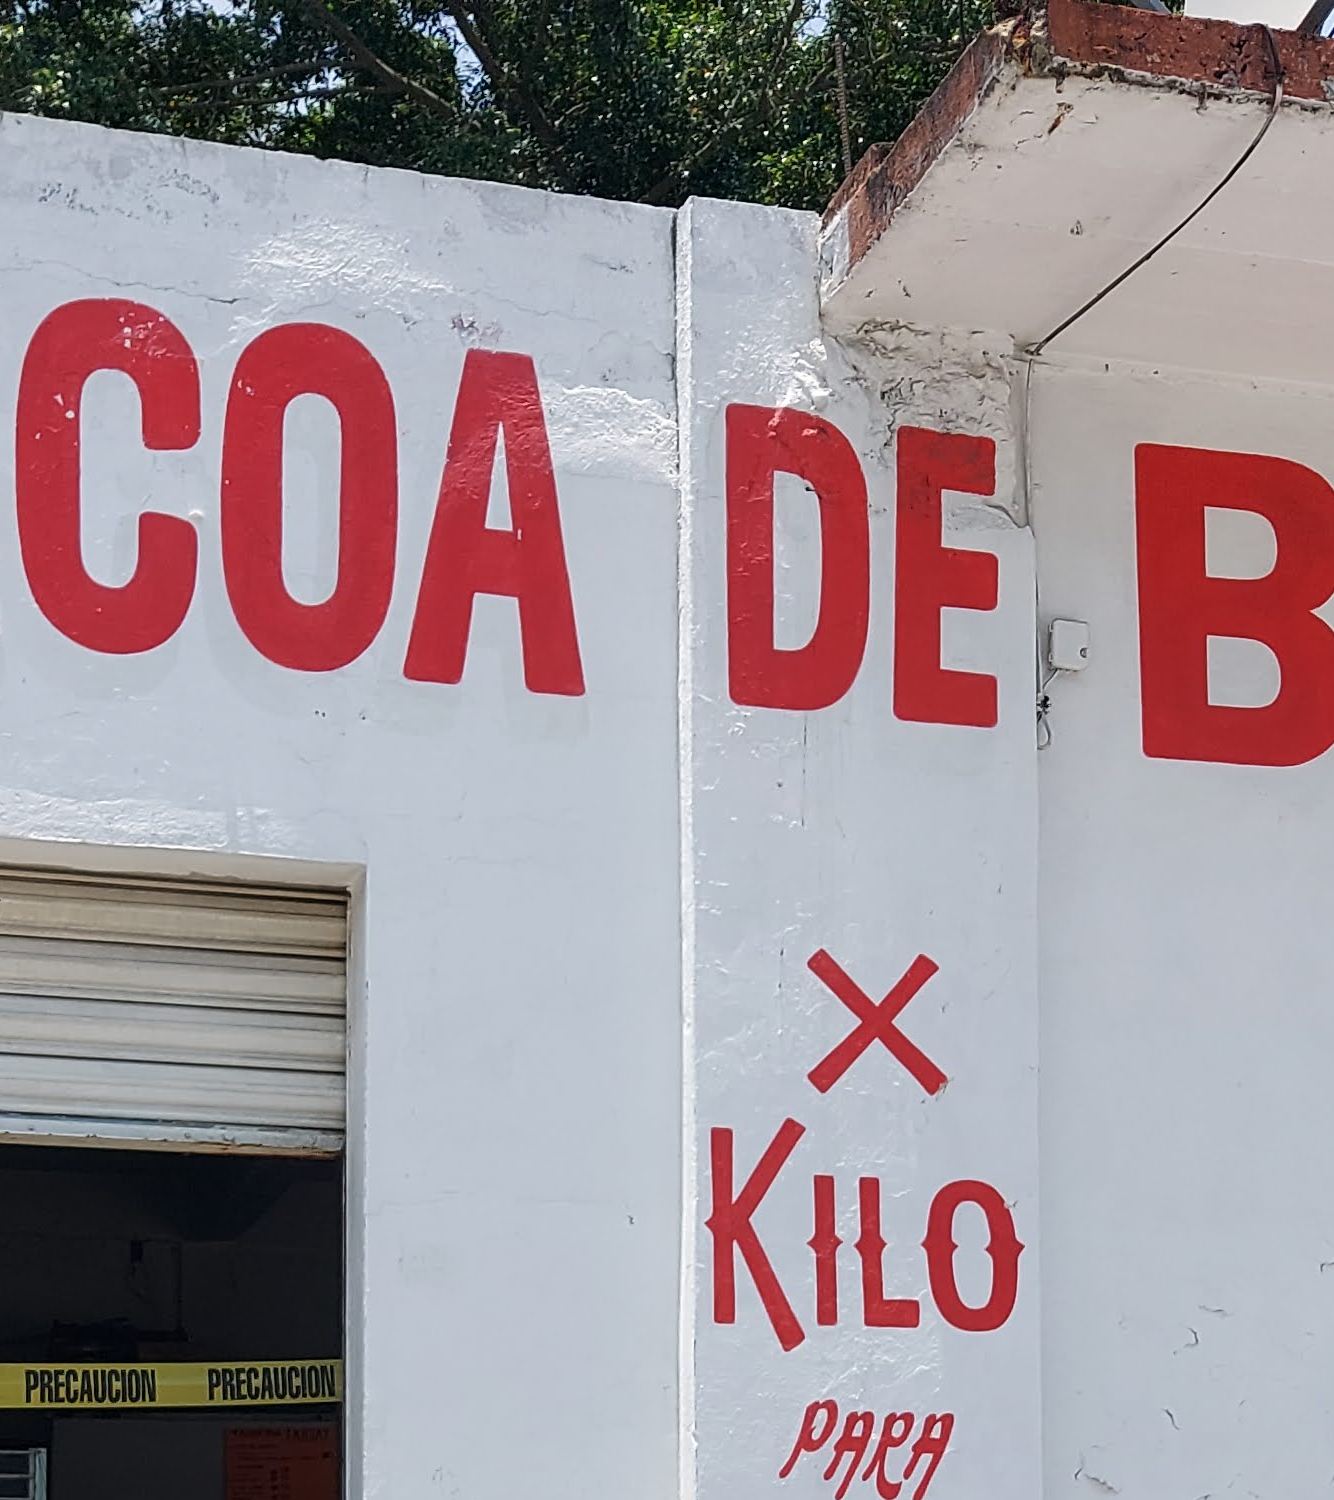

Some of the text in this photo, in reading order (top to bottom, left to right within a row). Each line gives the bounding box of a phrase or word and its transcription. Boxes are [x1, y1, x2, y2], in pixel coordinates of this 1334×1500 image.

[726, 404, 998, 727] DE
[807, 950, 948, 1096] X
[705, 1117, 1026, 1353] KILO
[24, 1368, 157, 1403] PRECAUCION
[206, 1364, 336, 1401] PRECAUCION
